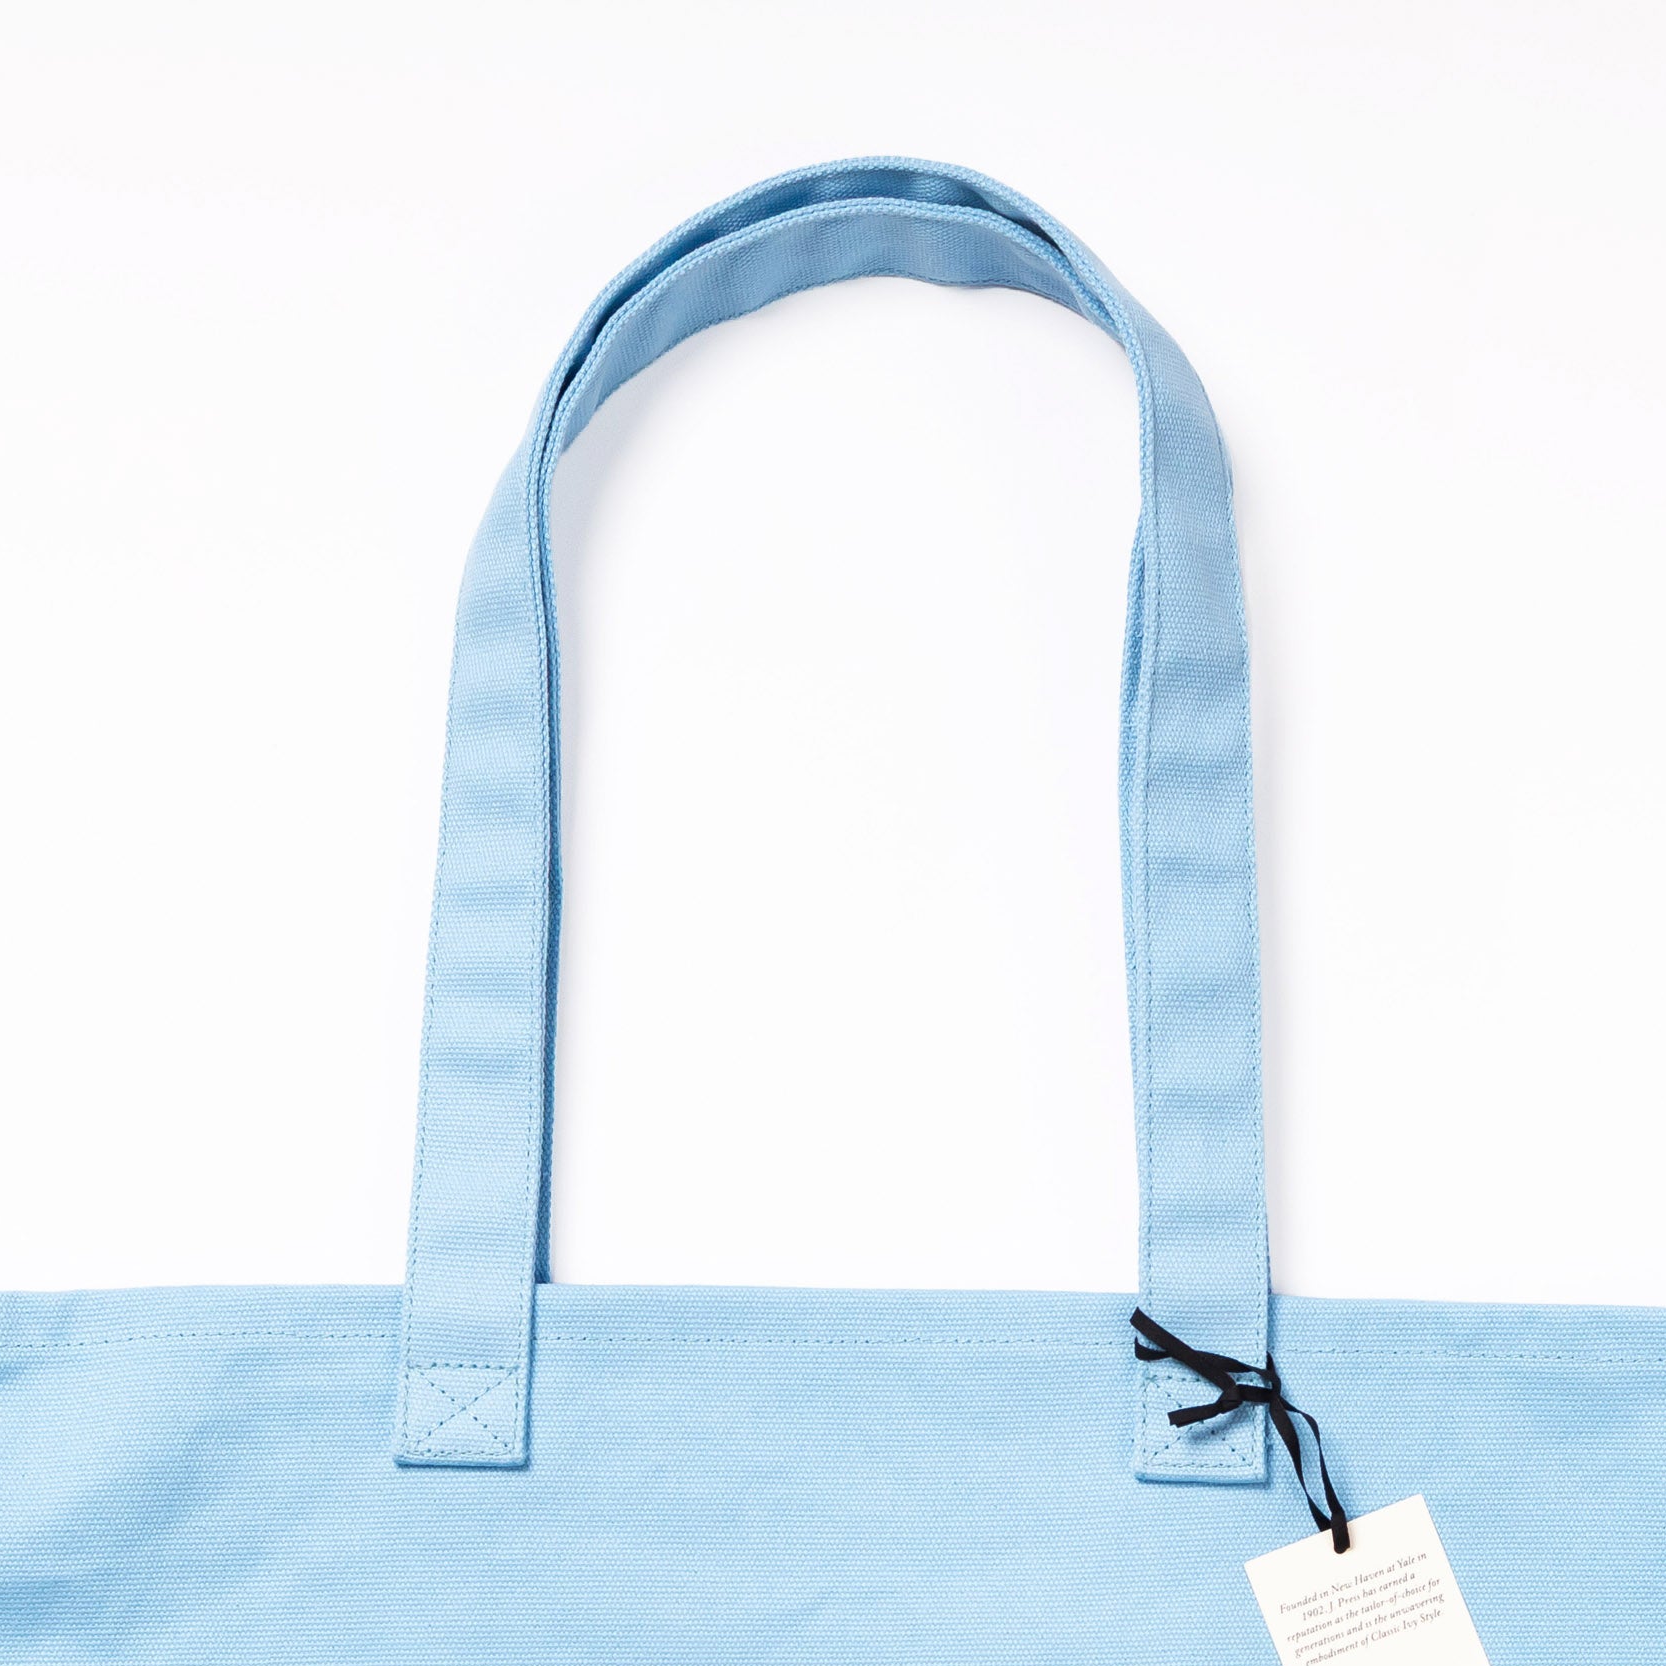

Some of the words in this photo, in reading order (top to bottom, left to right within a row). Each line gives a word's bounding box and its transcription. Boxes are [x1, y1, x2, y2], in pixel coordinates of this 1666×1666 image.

[1279, 1592, 1318, 1614] Founded
[1353, 1567, 1385, 1585] Haven
[1396, 1554, 1416, 1568] Yale
[1337, 1593, 1361, 1608] Press
[1378, 1572, 1409, 1593] earned
[1286, 1619, 1334, 1644] reputation
[1293, 1630, 1345, 1659] generations
[1389, 1592, 1445, 1620] unwavering
[1370, 1623, 1401, 1643] Classic
